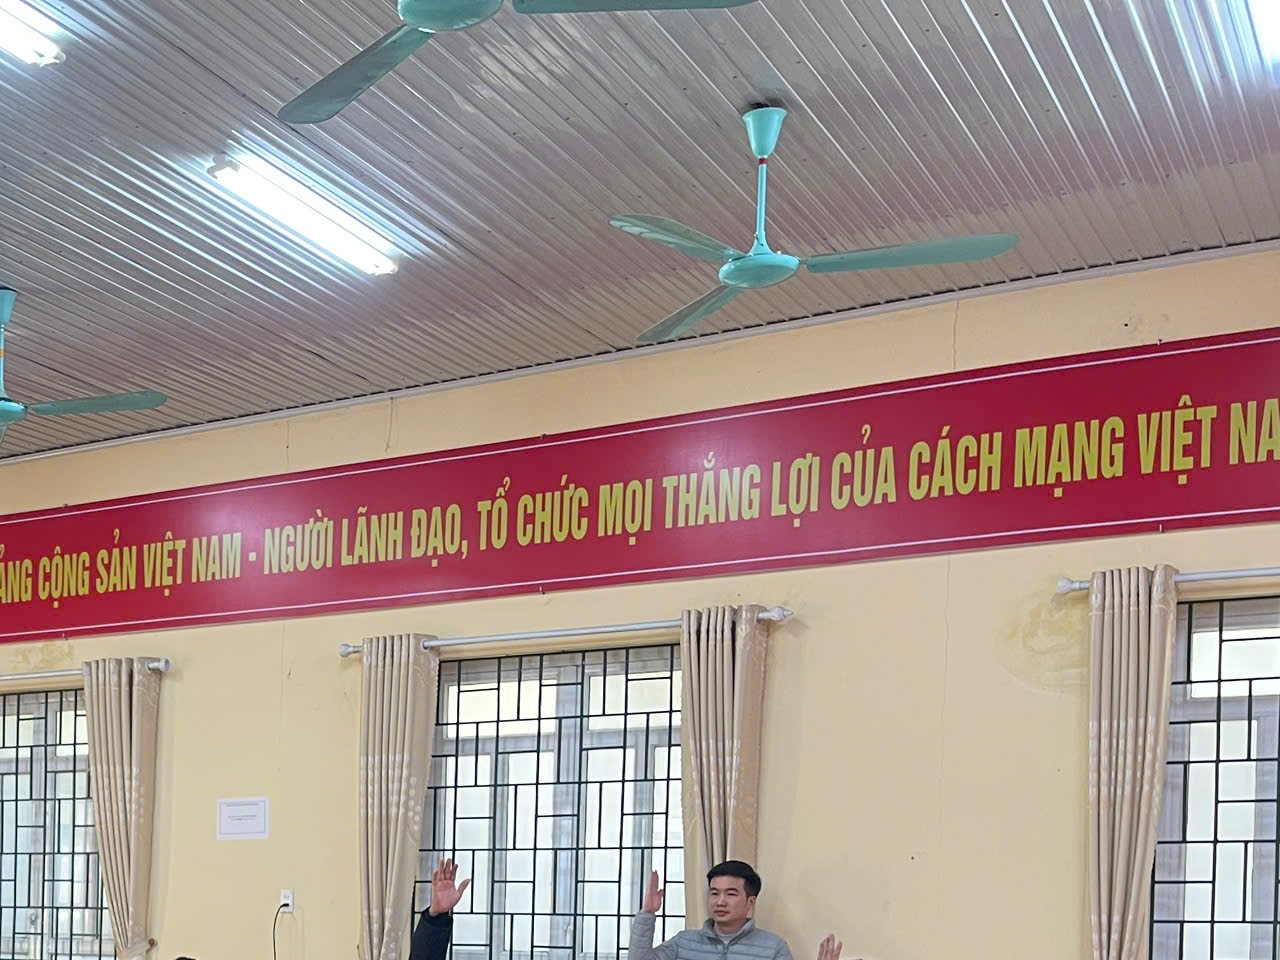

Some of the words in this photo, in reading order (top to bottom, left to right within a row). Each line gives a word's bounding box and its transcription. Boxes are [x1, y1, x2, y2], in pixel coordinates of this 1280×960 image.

[38, 551, 90, 609] CỘNG
[96, 528, 137, 594] SẢN
[142, 538, 187, 598] VIỆT
[191, 532, 242, 583] NAM
[263, 509, 333, 576] NGƯỜI
[341, 506, 403, 566] LÃNH
[410, 507, 467, 568] ĐẠO,
[477, 476, 511, 551] TỔ
[517, 474, 588, 546] CHỨC
[598, 478, 653, 545] MỌI
[662, 450, 761, 529] THẮNG
[771, 452, 821, 528] LỢI
[831, 424, 898, 511] CỦA
[908, 425, 1003, 500] CÁCH
[1014, 416, 1123, 497] MẠNG
[1137, 394, 1218, 485] VIỆT
